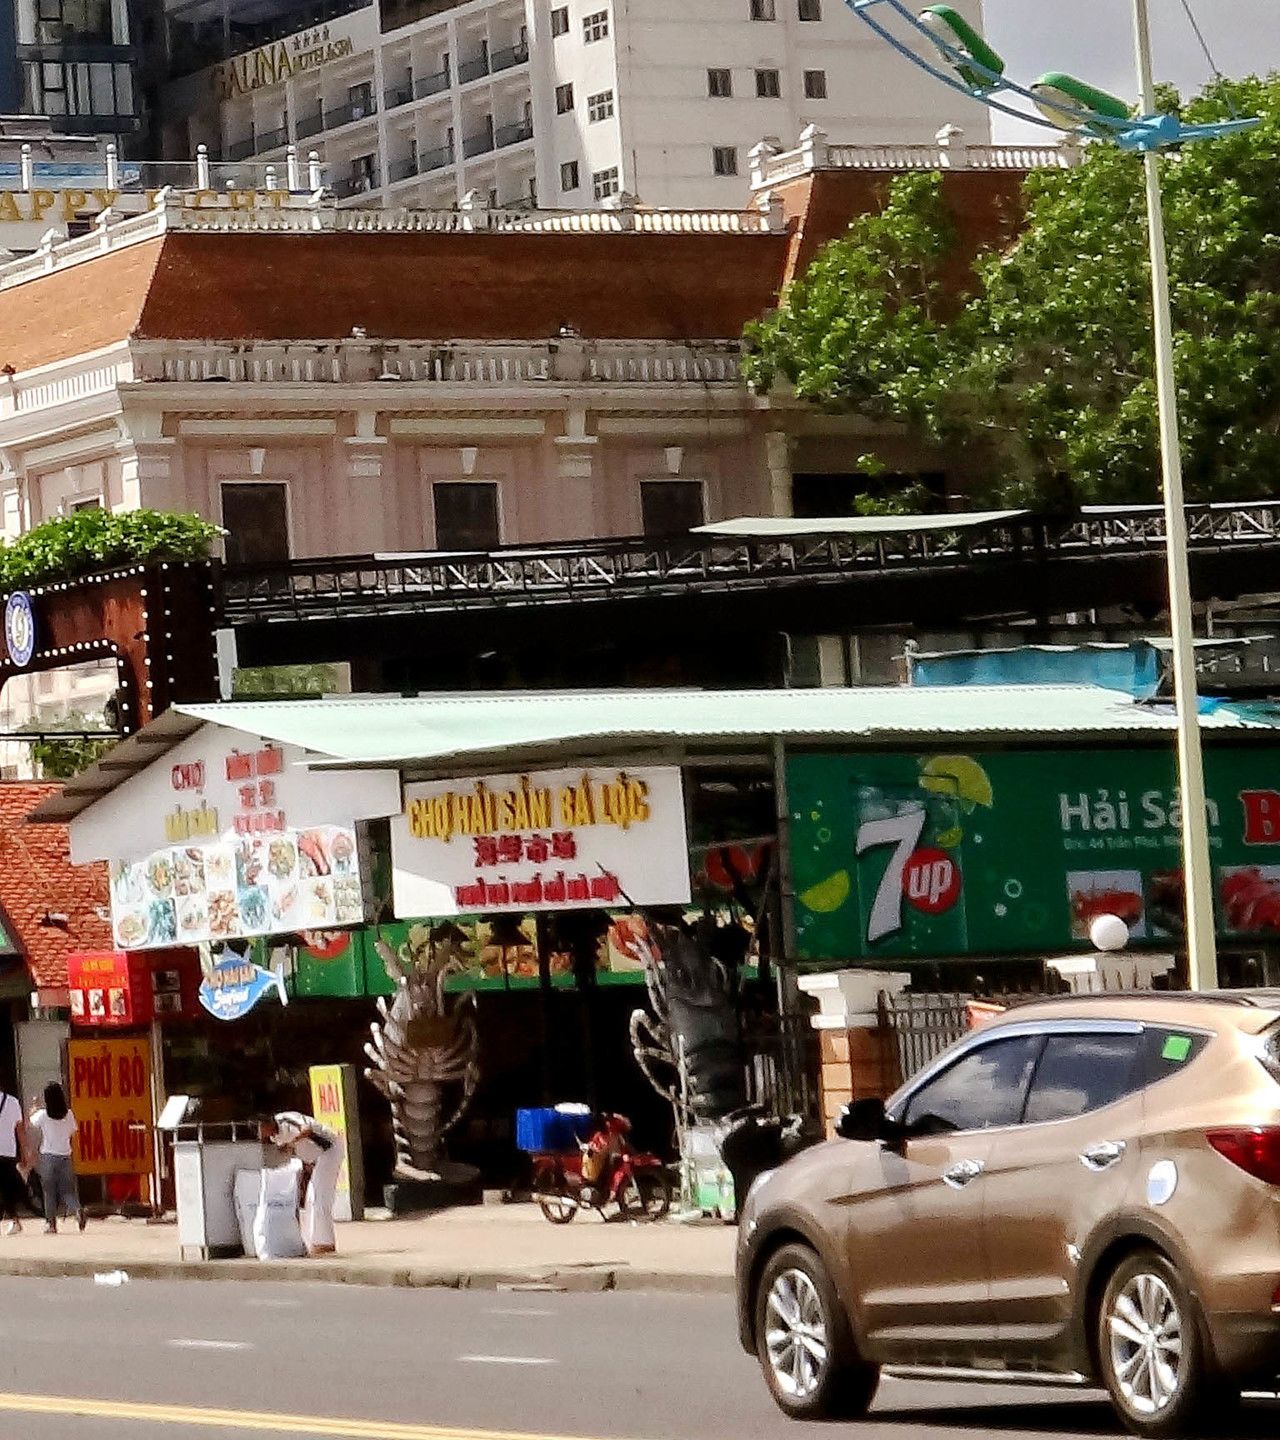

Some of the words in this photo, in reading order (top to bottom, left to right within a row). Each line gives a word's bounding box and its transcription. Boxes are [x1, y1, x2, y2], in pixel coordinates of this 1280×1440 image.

[406, 792, 455, 843] CHỢ
[1058, 788, 1131, 831] Hải
[74, 1045, 112, 1098] PHỞ
[78, 1112, 107, 1162] HÀ
